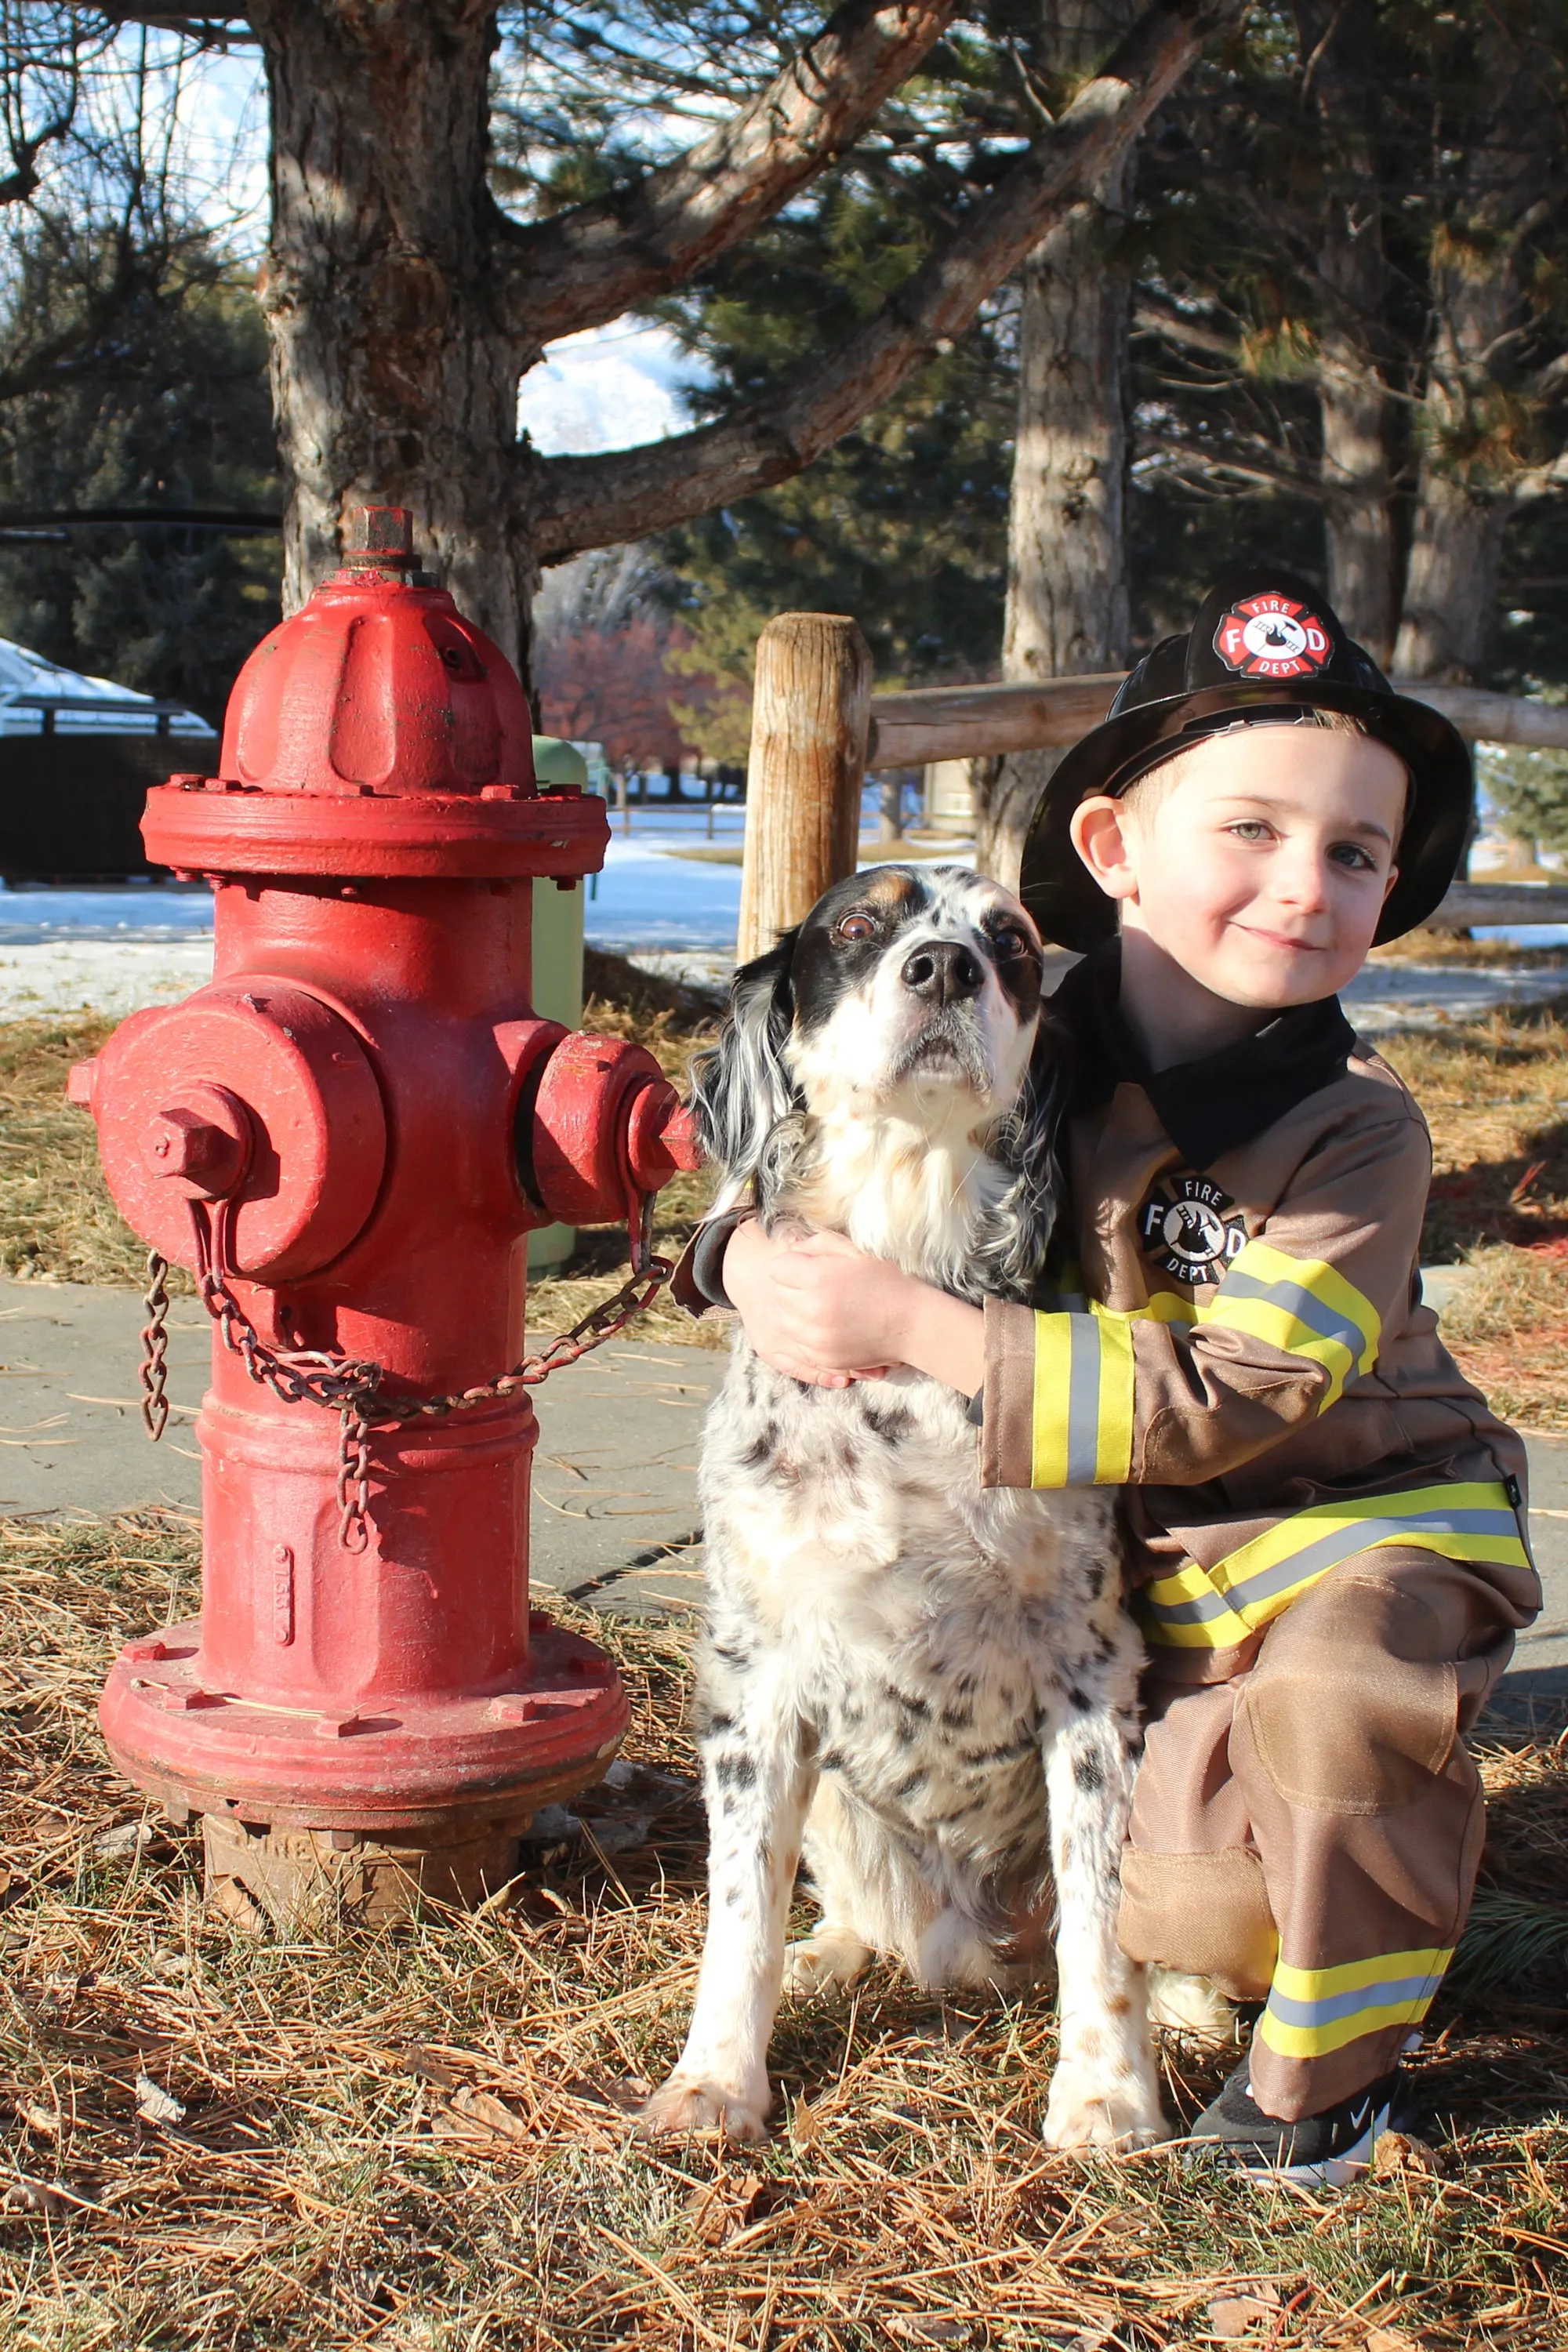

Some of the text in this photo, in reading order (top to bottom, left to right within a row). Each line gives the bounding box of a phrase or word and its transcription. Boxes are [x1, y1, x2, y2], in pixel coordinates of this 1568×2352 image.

[1251, 600, 1290, 614] FIRE
[1225, 628, 1325, 653] F D
[1258, 660, 1301, 674] DEPT
[1185, 1181, 1222, 1207] FIRE
[1145, 1204, 1247, 1258] F D
[1166, 1258, 1207, 1282] DEPT
